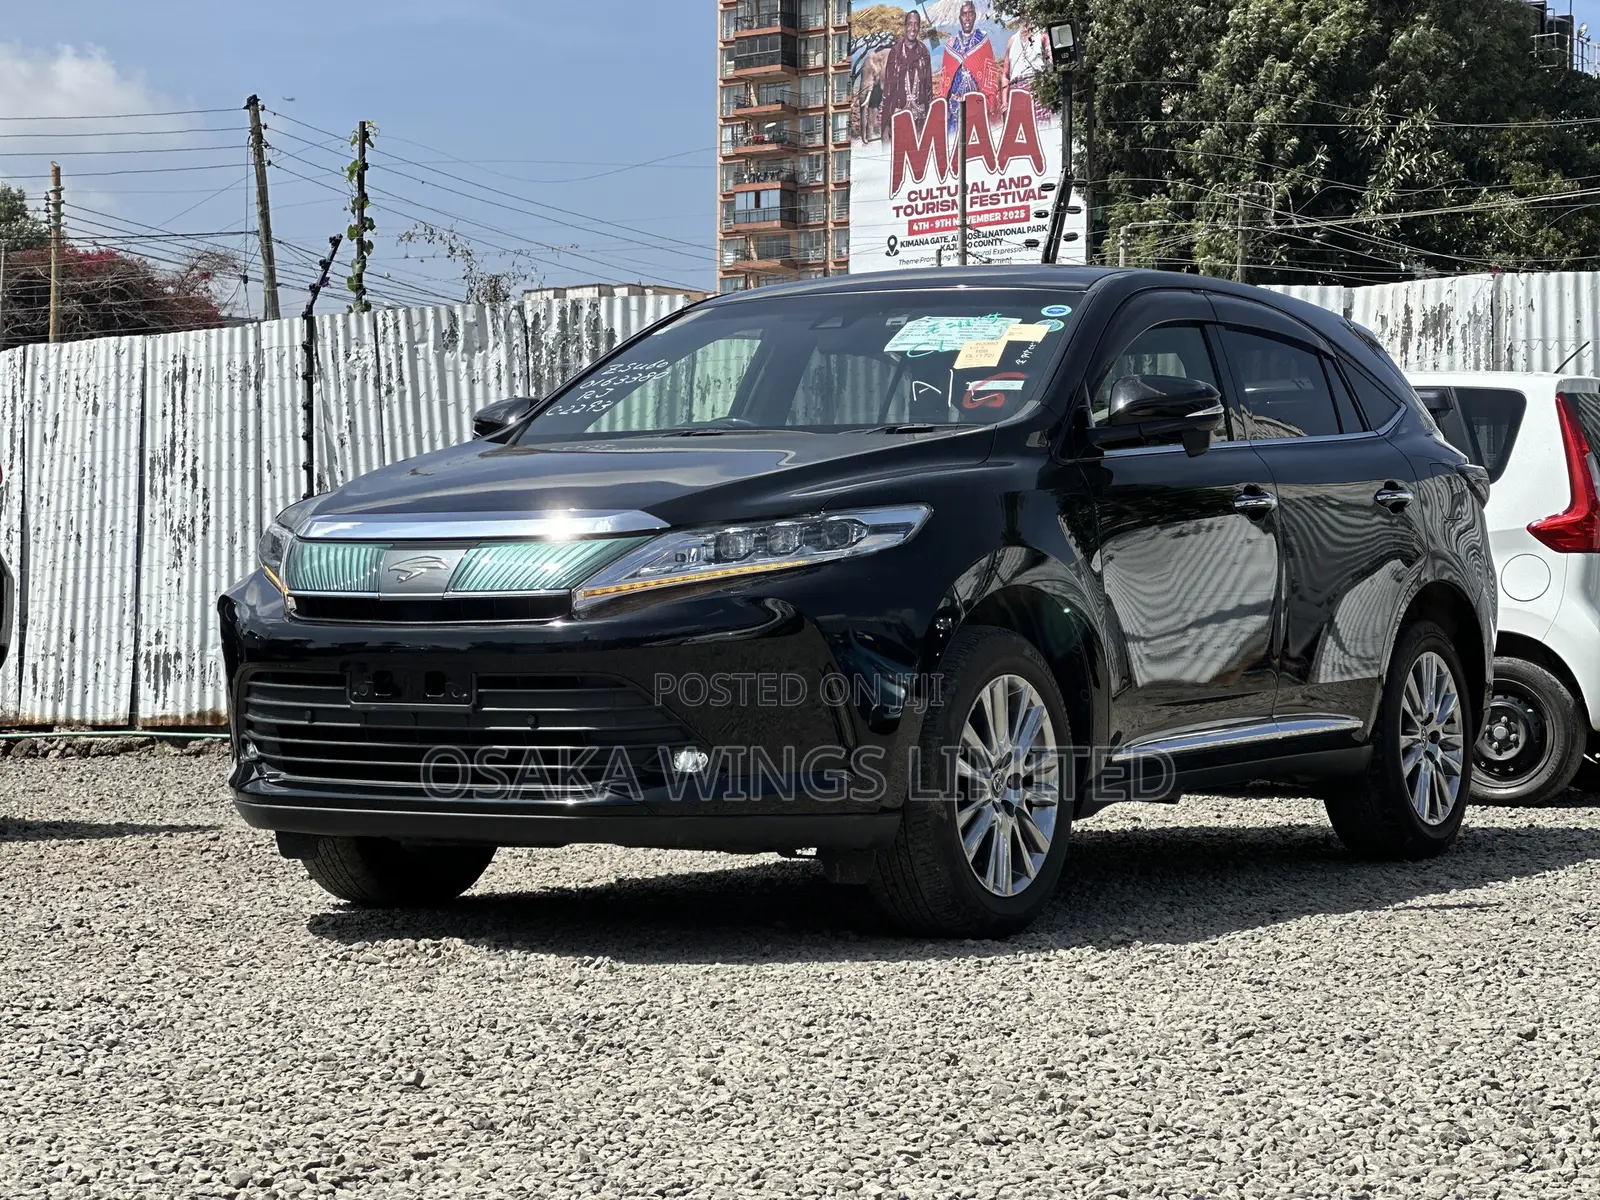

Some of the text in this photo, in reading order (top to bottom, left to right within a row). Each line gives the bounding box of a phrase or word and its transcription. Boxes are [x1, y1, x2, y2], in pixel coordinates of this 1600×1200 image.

[889, 89, 1047, 200] MAA
[997, 175, 1032, 191] AND
[969, 187, 1048, 209] FESTIVAL
[913, 221, 929, 231] 4TH
[935, 219, 951, 229] 9TH
[952, 212, 1001, 227] NVEMBER
[1002, 209, 1025, 220] 2025
[900, 237, 929, 248] KIMANA
[951, 230, 988, 243] AOSELI
[988, 226, 1026, 238] NATIONAL
[940, 238, 1004, 251] KAJIO COUNTY
